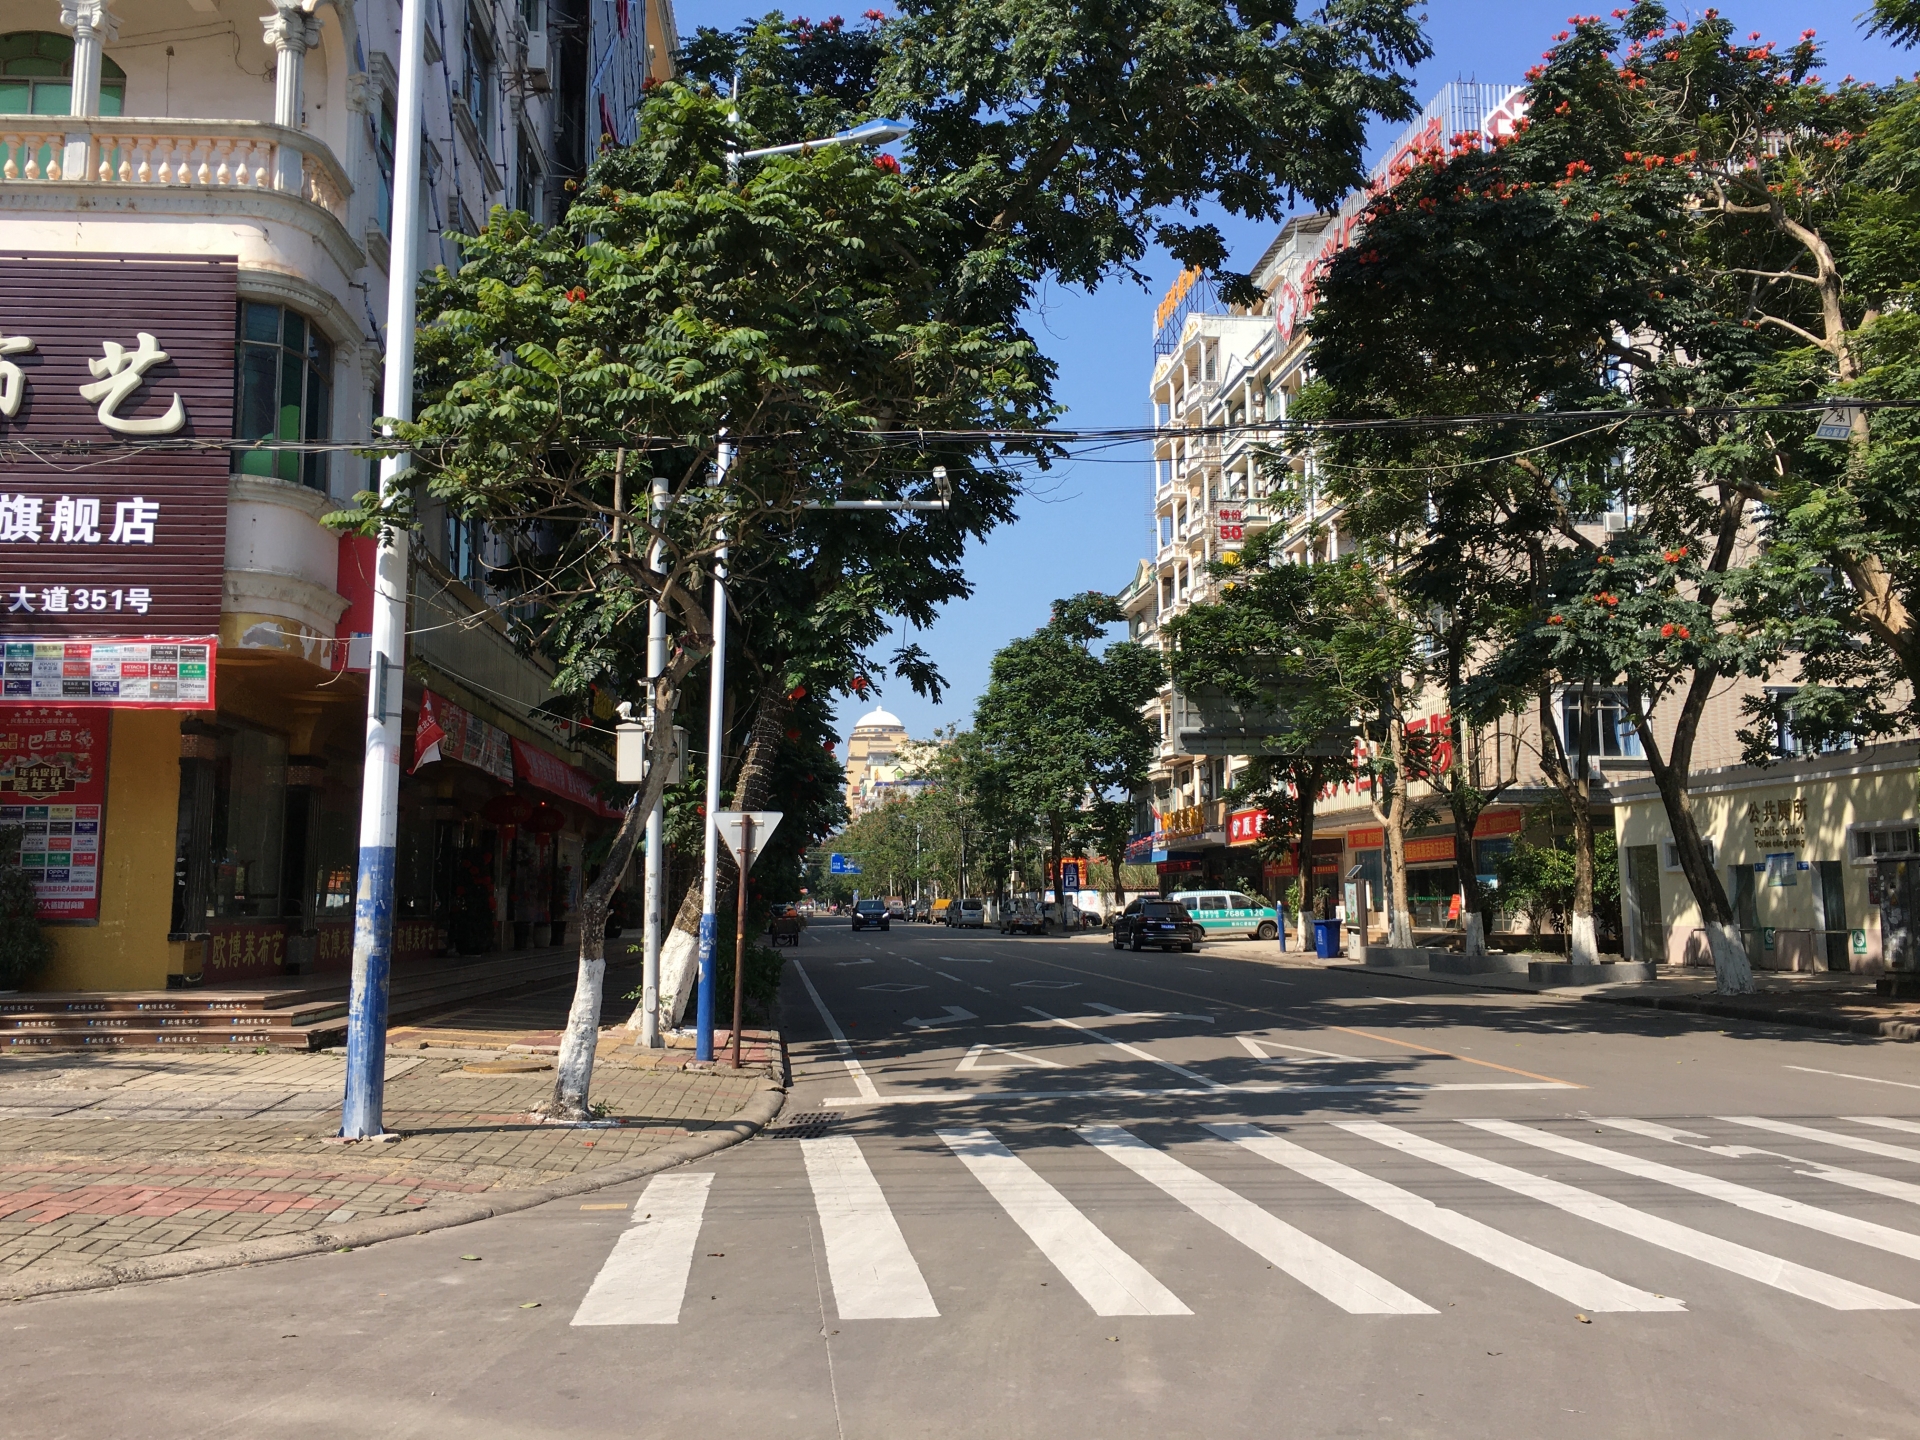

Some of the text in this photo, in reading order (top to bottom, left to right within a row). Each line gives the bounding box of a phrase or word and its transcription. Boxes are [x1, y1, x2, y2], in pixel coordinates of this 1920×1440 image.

[0, 494, 160, 544] 旗舰店
[1219, 510, 1241, 521] 特价
[1220, 525, 1242, 540] 50
[28, 729, 72, 750] 巴厘岛
[19, 768, 61, 777] 年末促销
[12, 776, 66, 790] 嘉年华
[1748, 798, 1808, 823] 公共厕所
[1754, 825, 1805, 837] Public toilet
[1067, 875, 1075, 885] P
[1249, 909, 1264, 917] 120
[397, 926, 435, 951] 欧博莱布艺
[212, 932, 284, 969] 欧博莱布艺
